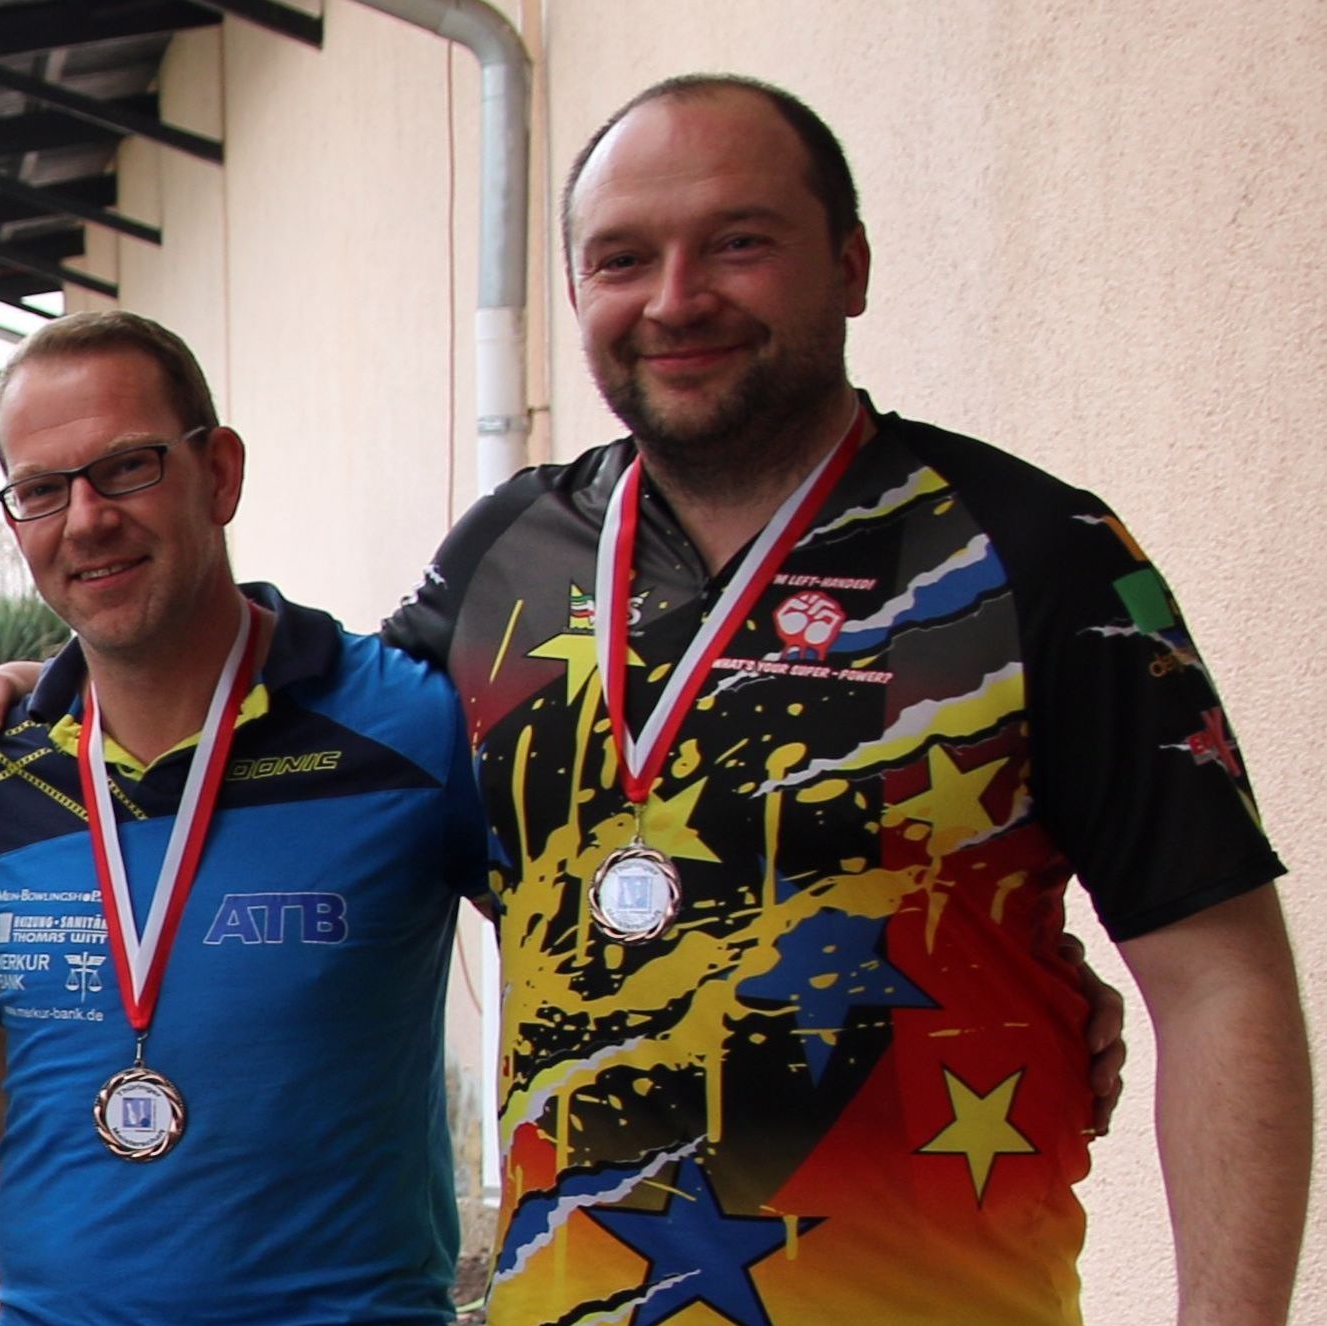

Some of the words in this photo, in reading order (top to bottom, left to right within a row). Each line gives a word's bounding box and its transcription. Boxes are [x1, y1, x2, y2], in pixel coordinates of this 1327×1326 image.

[757, 660, 790, 674] YOUR
[789, 664, 831, 679] SUPER
[838, 668, 894, 684] POWER?
[226, 751, 342, 781] DONIC
[203, 891, 349, 946] ATB
[12, 932, 66, 943] THOMAS
[70, 932, 108, 944] WITT
